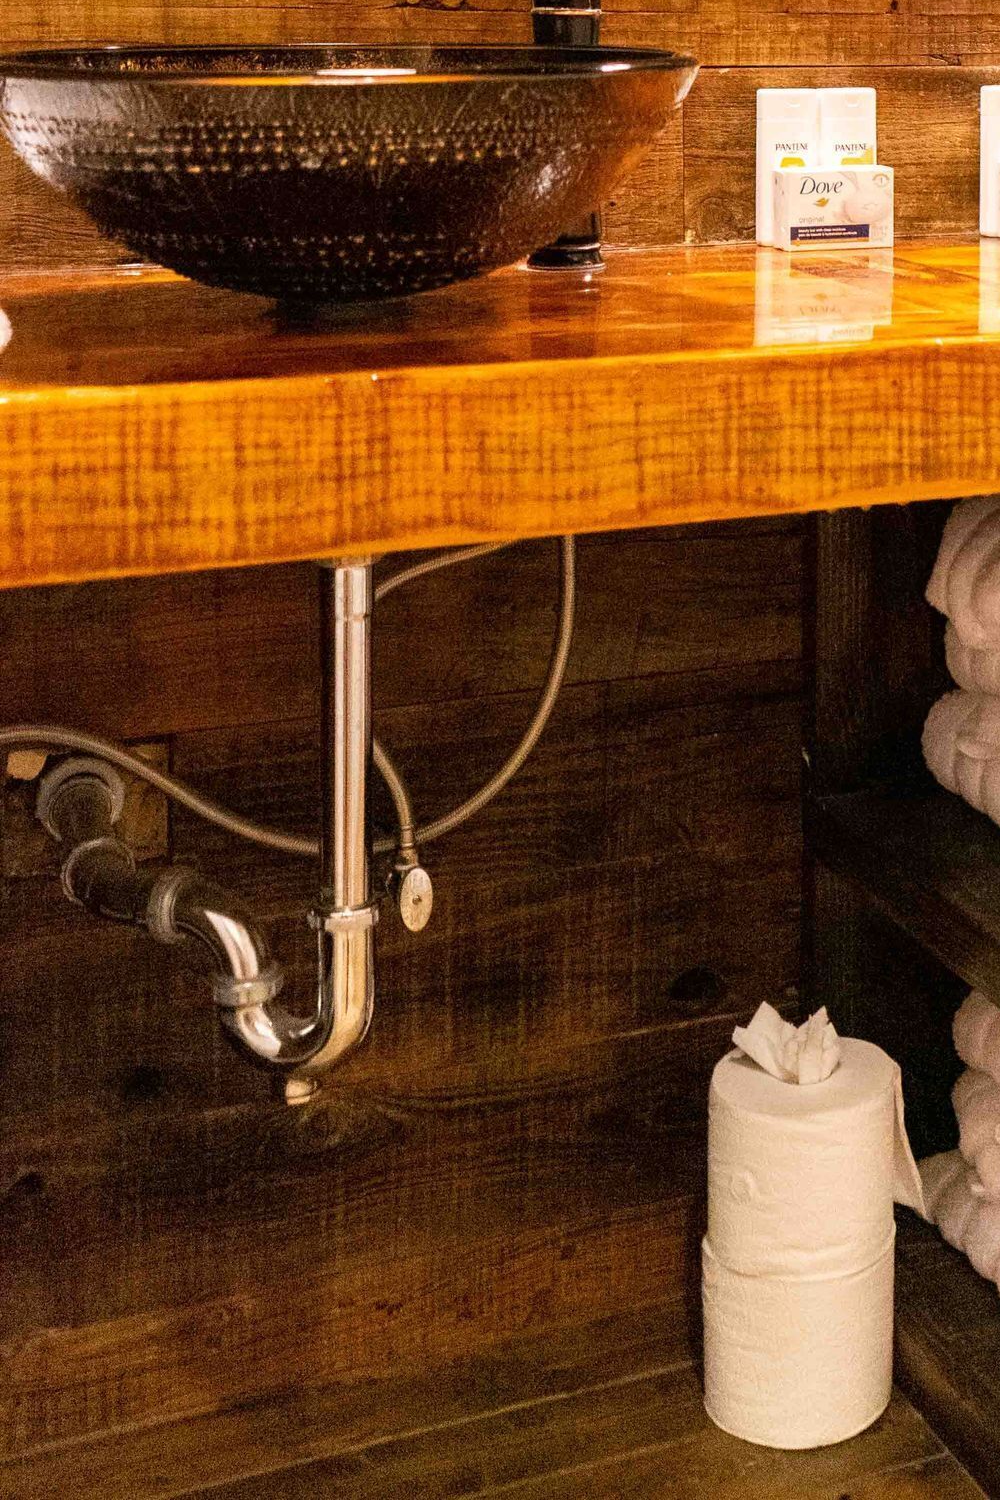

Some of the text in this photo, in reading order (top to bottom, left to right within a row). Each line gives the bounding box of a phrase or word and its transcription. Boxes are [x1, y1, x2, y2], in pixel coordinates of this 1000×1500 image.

[775, 143, 809, 151] PANTENE
[835, 143, 867, 151] PANTENE
[799, 176, 843, 195] Dove
